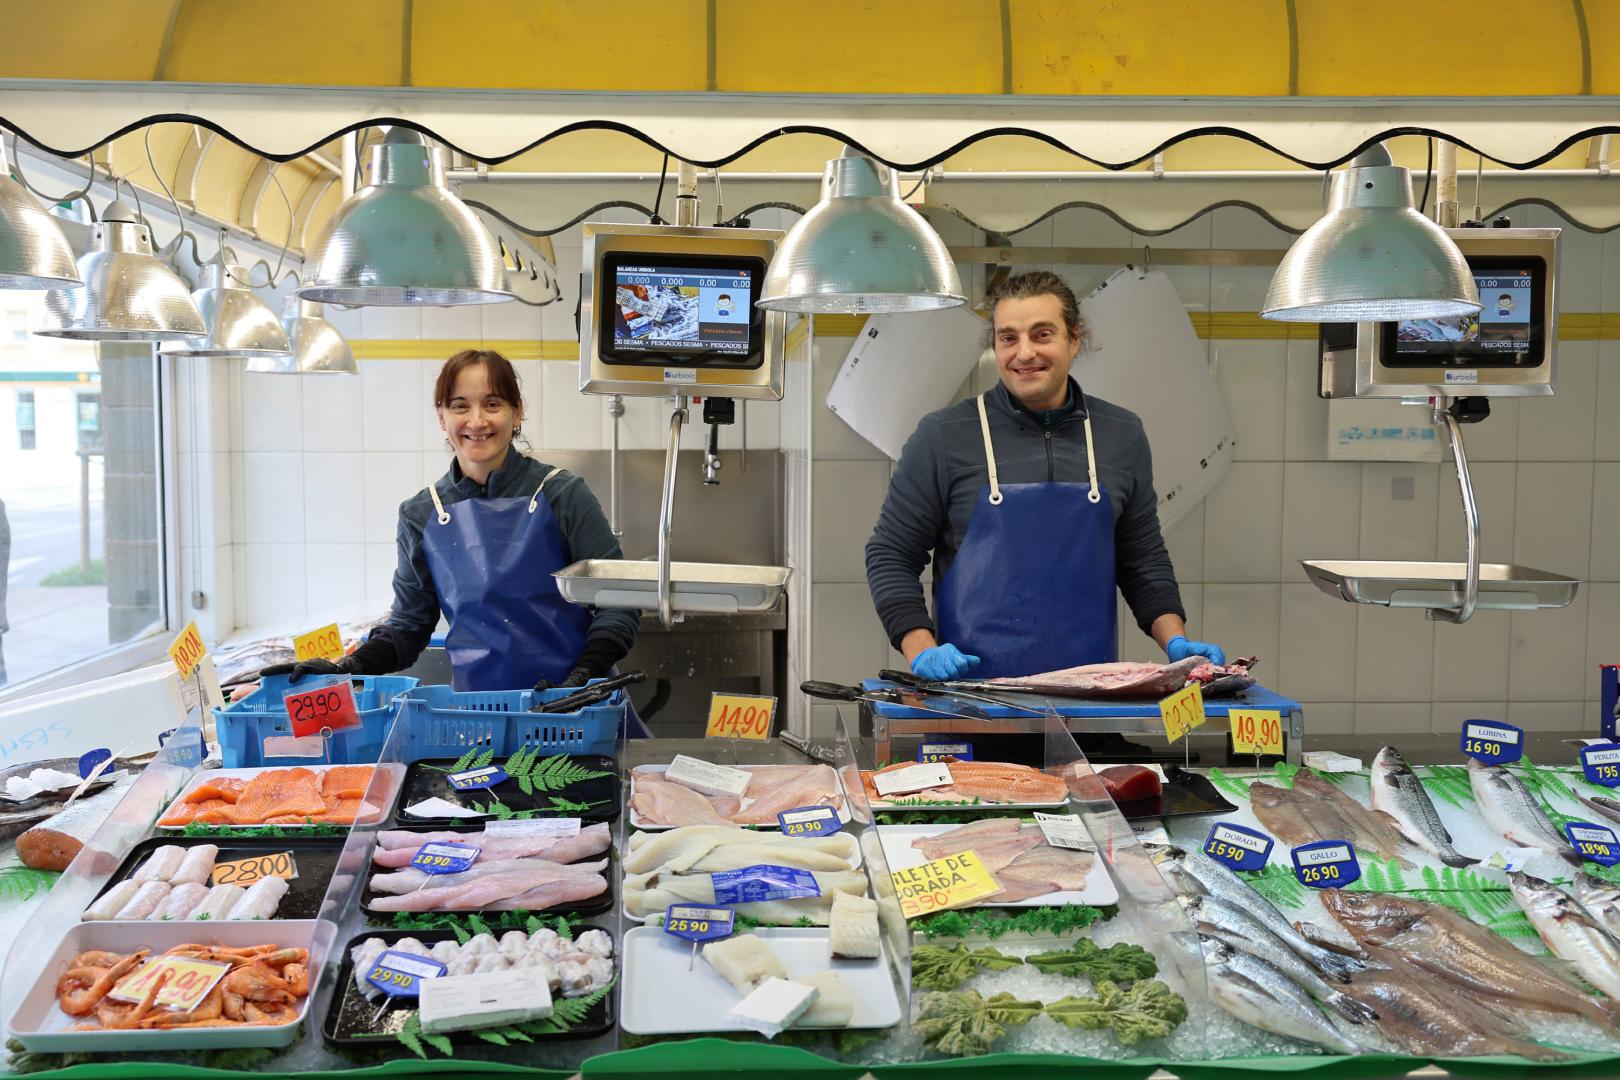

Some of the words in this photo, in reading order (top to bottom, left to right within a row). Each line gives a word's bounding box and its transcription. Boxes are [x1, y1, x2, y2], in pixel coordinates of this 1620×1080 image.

[1478, 729, 1507, 739] LUBINA
[1224, 831, 1258, 848] DORADA
[945, 854, 972, 870] DE
[1310, 851, 1338, 860] GALLO
